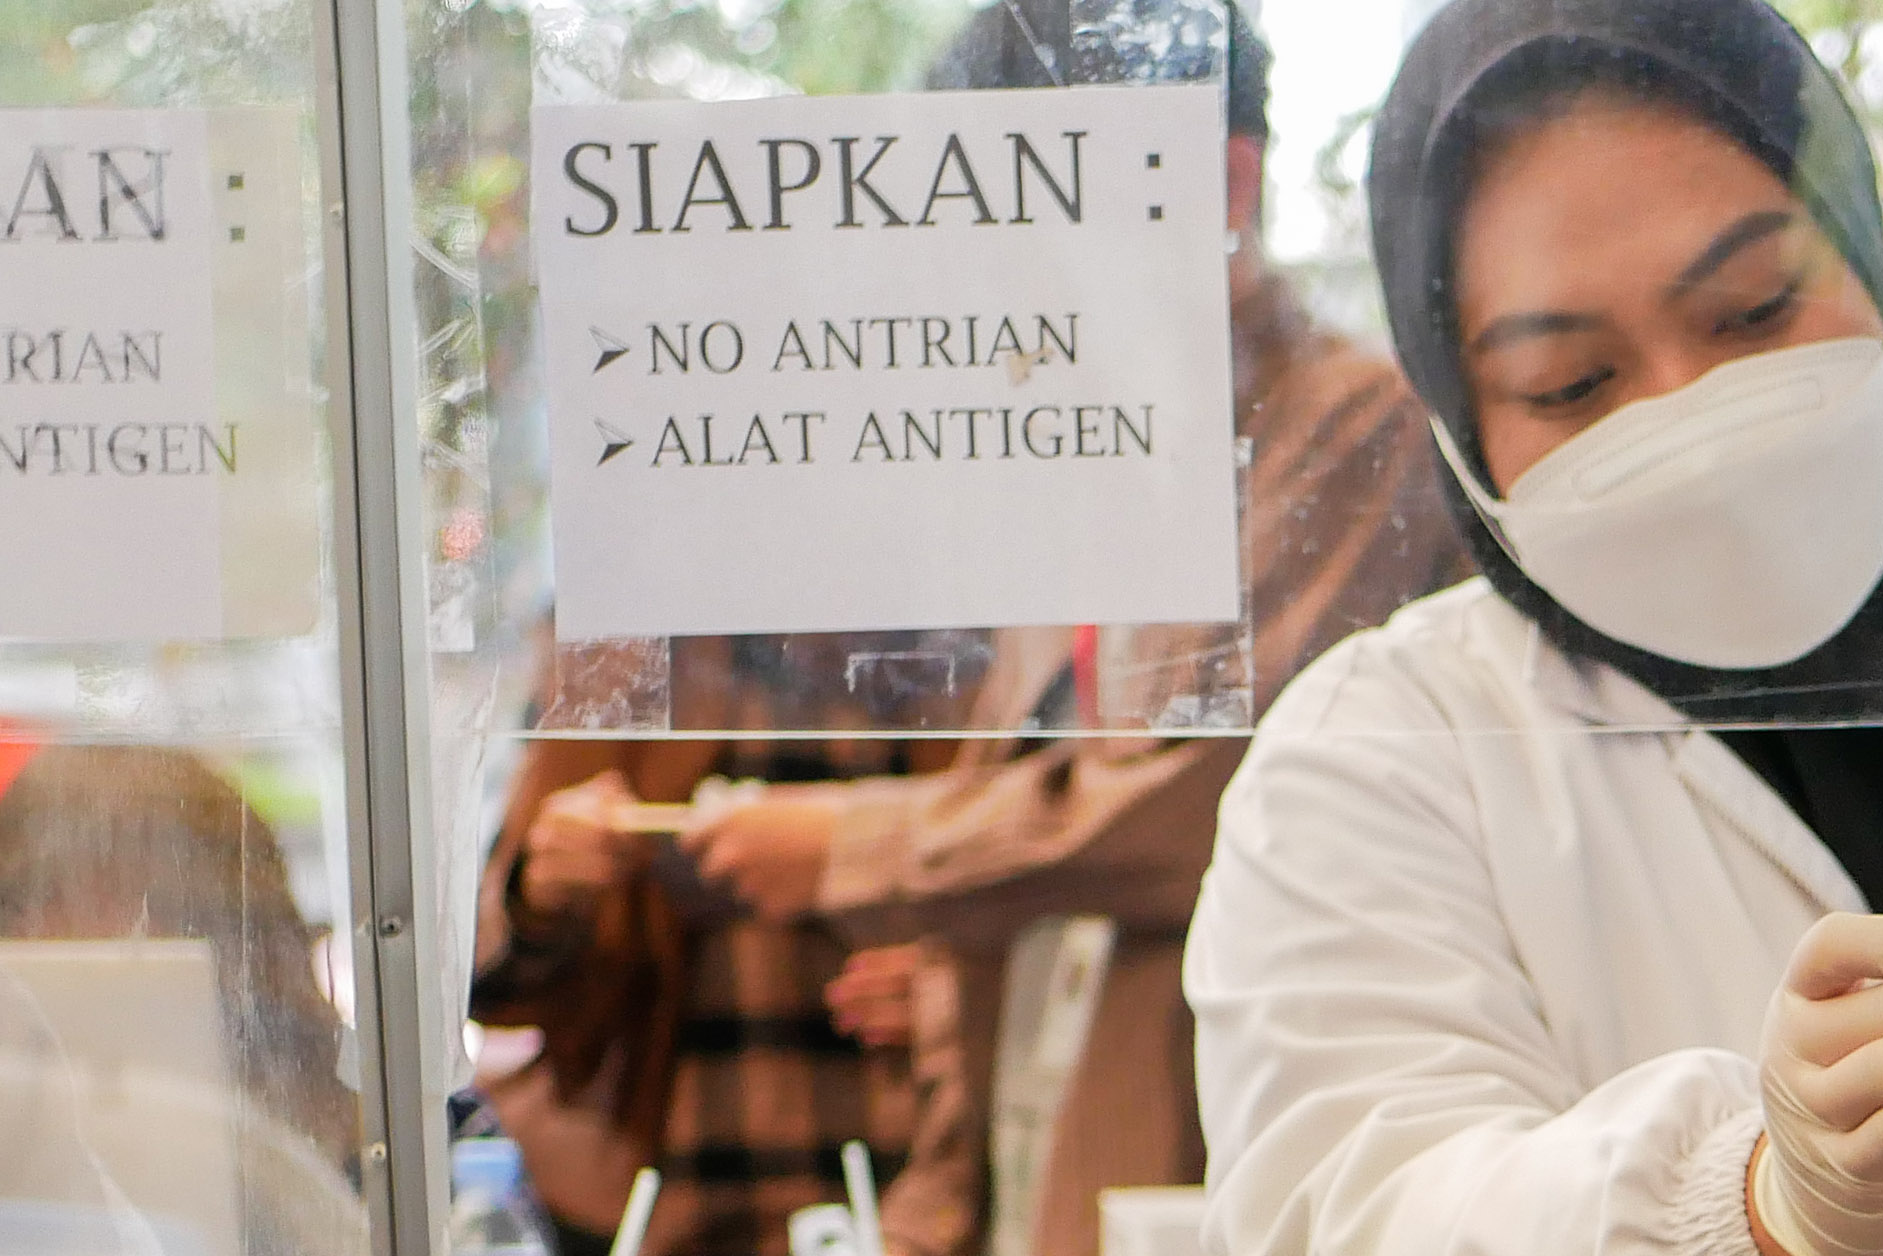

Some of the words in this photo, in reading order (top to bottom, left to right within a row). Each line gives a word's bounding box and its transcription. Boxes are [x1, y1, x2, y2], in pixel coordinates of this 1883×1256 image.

[563, 131, 1088, 236] SIAPKAN
[1146, 153, 1163, 221] :
[646, 320, 745, 375] NO
[772, 314, 1080, 371] ANTRIAN
[651, 413, 826, 467] ALAT
[851, 406, 1154, 462] ANTIGEN
